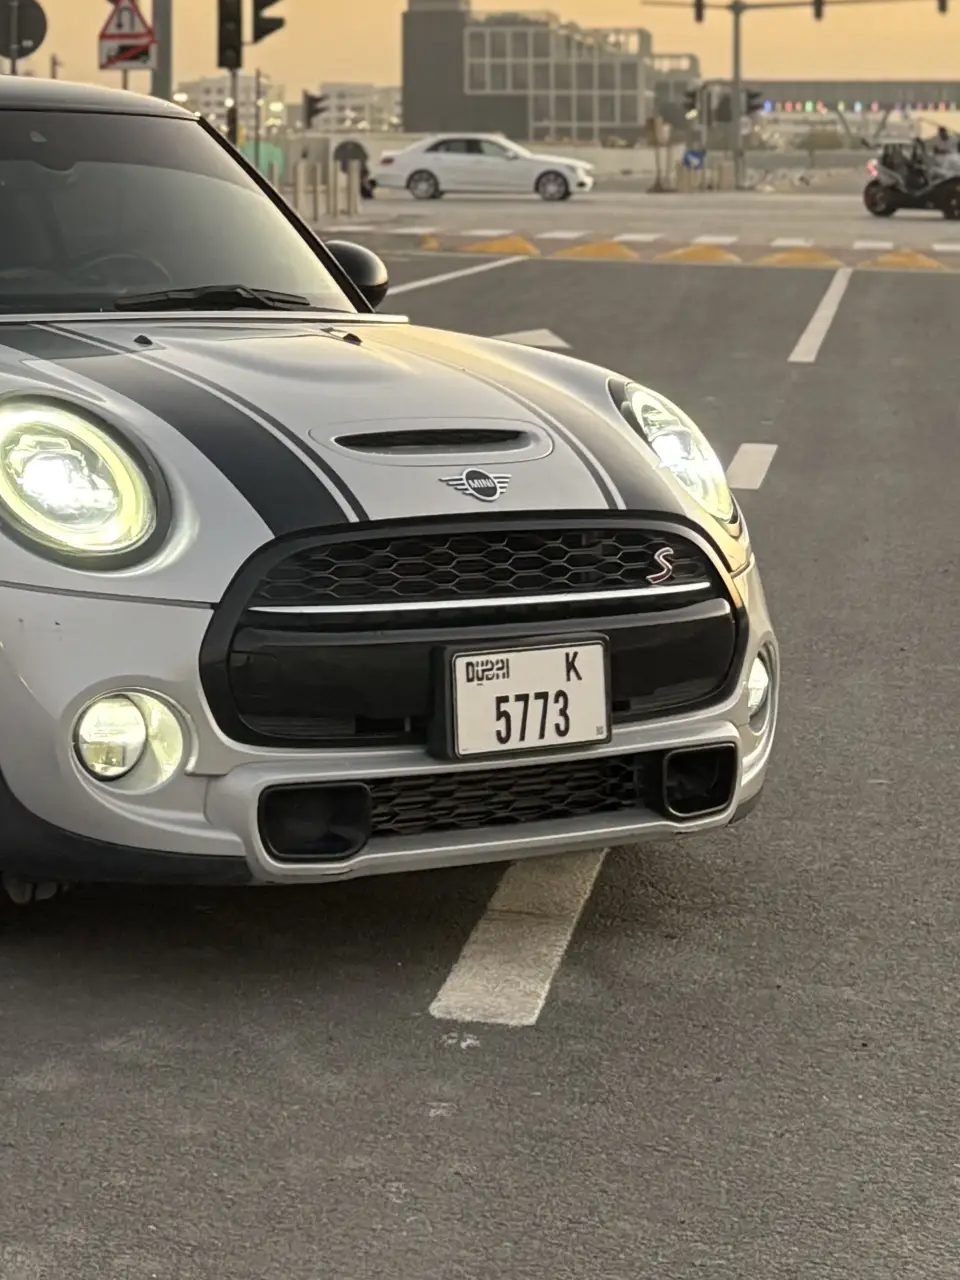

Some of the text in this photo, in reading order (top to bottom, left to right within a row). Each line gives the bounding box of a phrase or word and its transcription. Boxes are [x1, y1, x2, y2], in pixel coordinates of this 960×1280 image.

[468, 478, 496, 489] MINI
[646, 546, 674, 584] S
[565, 651, 583, 682] K
[495, 689, 570, 744] 5773
